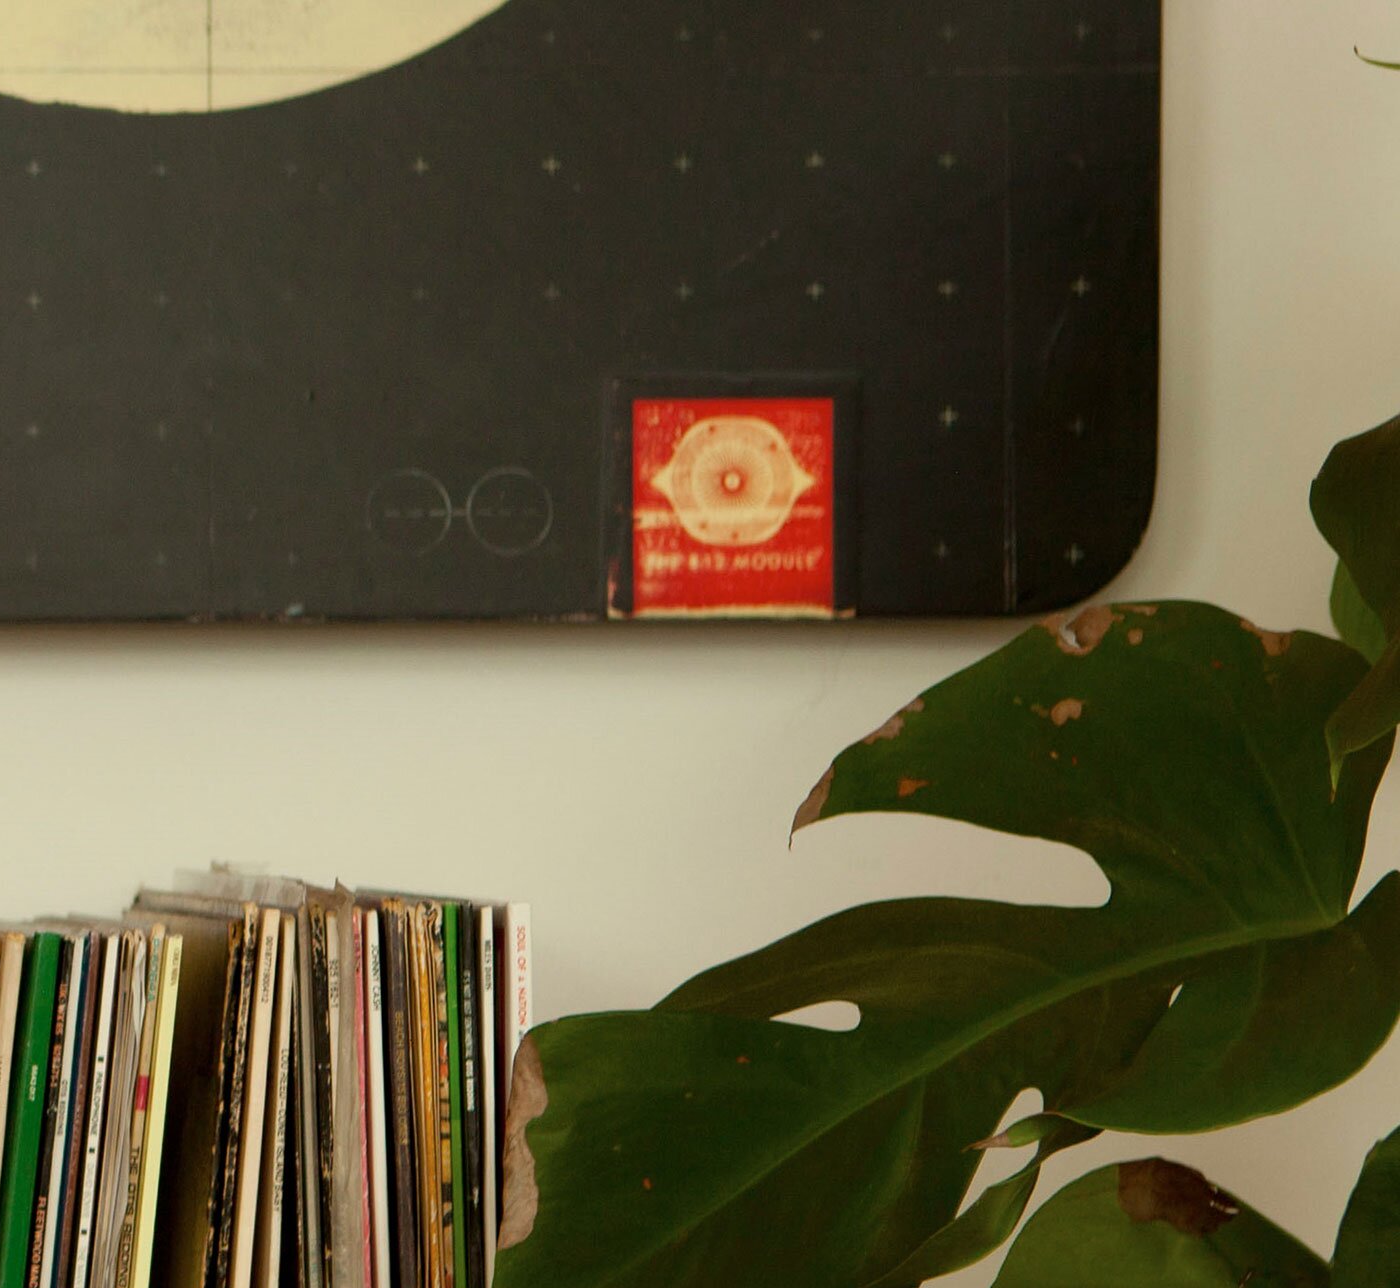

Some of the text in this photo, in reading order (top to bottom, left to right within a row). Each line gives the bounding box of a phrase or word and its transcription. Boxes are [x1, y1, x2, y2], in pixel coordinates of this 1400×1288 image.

[517, 926, 525, 951] SOUL
[371, 944, 380, 1010] JOHNNY CASH
[517, 957, 525, 970] OF
[517, 987, 526, 1025] NATION
[394, 1011, 404, 1046] BEACH
[280, 1048, 289, 1069] LOU
[278, 1072, 287, 1098] REED
[89, 1072, 103, 1135] PARLOPHONE
[276, 1109, 286, 1141] CONEY
[127, 1145, 139, 1175] THE
[274, 1147, 284, 1182] ISLAND
[124, 1182, 136, 1215] OTIS
[31, 1196, 46, 1263] FLEETWOOD
[117, 1223, 132, 1288] REDDING
